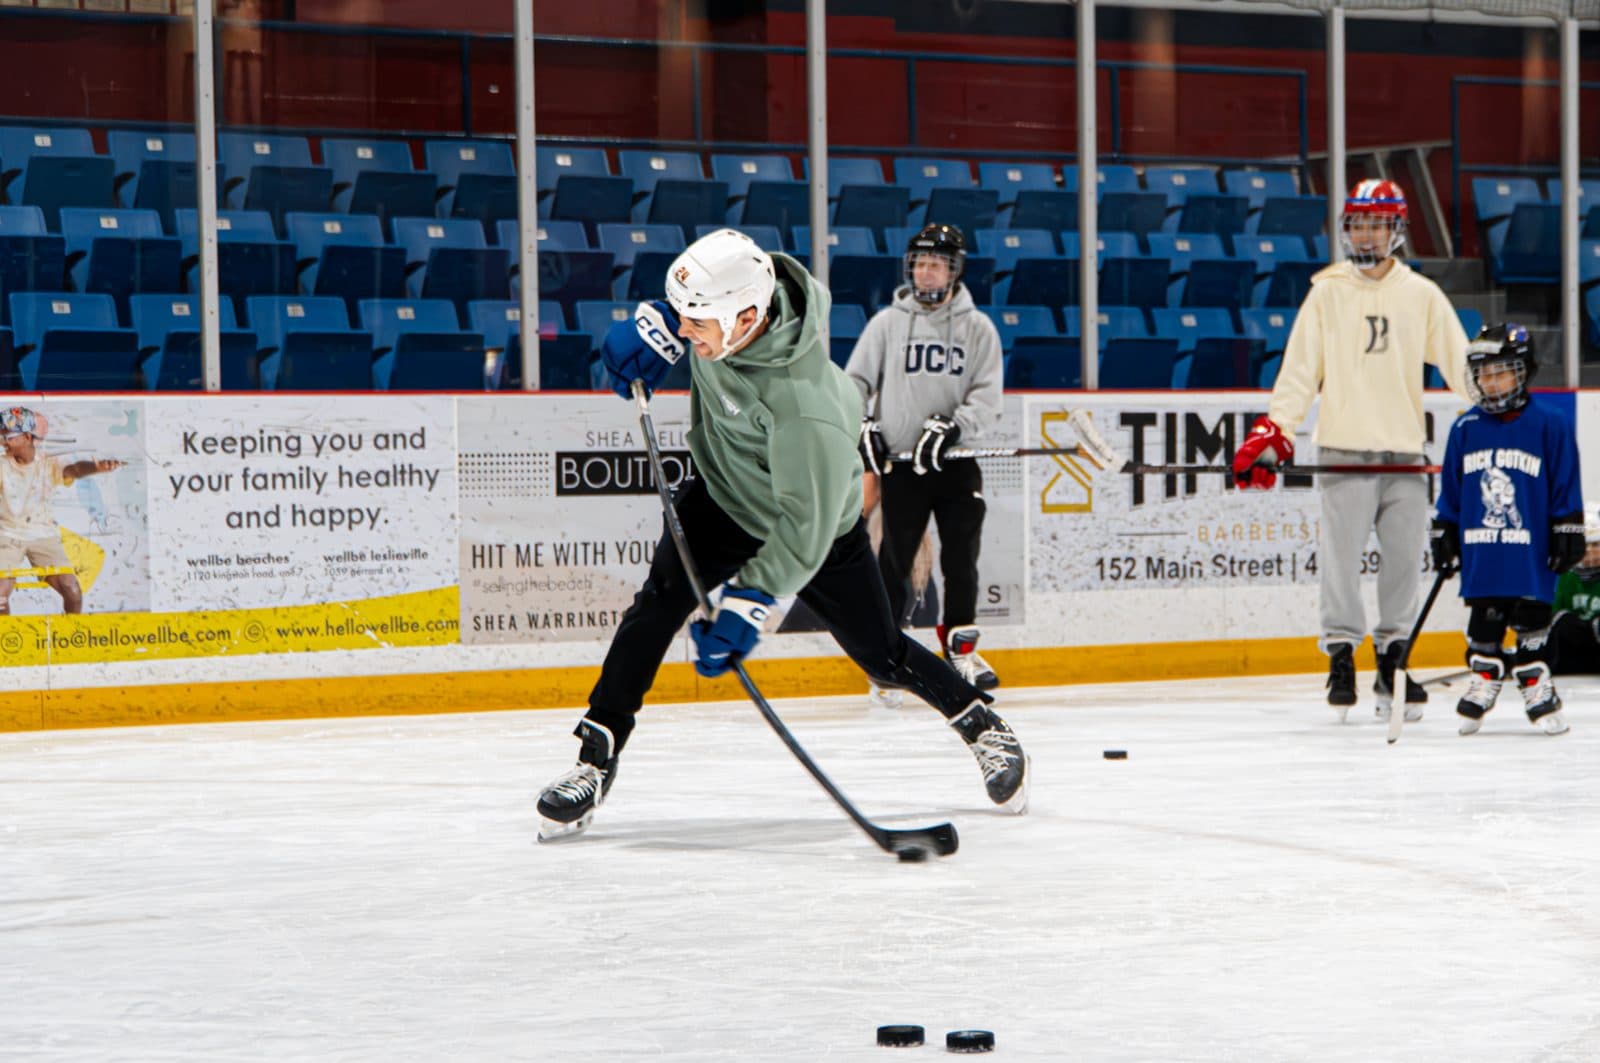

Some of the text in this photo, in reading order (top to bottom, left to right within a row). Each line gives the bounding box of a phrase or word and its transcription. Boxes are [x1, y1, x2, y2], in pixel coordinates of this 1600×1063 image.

[636, 316, 680, 360] CCM
[904, 343, 965, 376] UCC
[182, 427, 426, 459] Keeping you and
[586, 431, 634, 447] SHEA
[169, 463, 440, 499] your family healthy
[226, 503, 389, 531] and happy.
[187, 552, 289, 566] wellbe beaches
[323, 550, 366, 562] wellbe
[472, 544, 506, 568] HIT
[515, 542, 544, 567] ME
[553, 541, 606, 566] WITH
[1095, 557, 1136, 581] 152
[1146, 555, 1203, 579] Main
[1212, 554, 1283, 577] Street
[276, 615, 459, 638] www.hellowellbe.com
[473, 610, 625, 631] SHEA WARRINGT
[36, 625, 231, 650] info@hellowellbe.com
